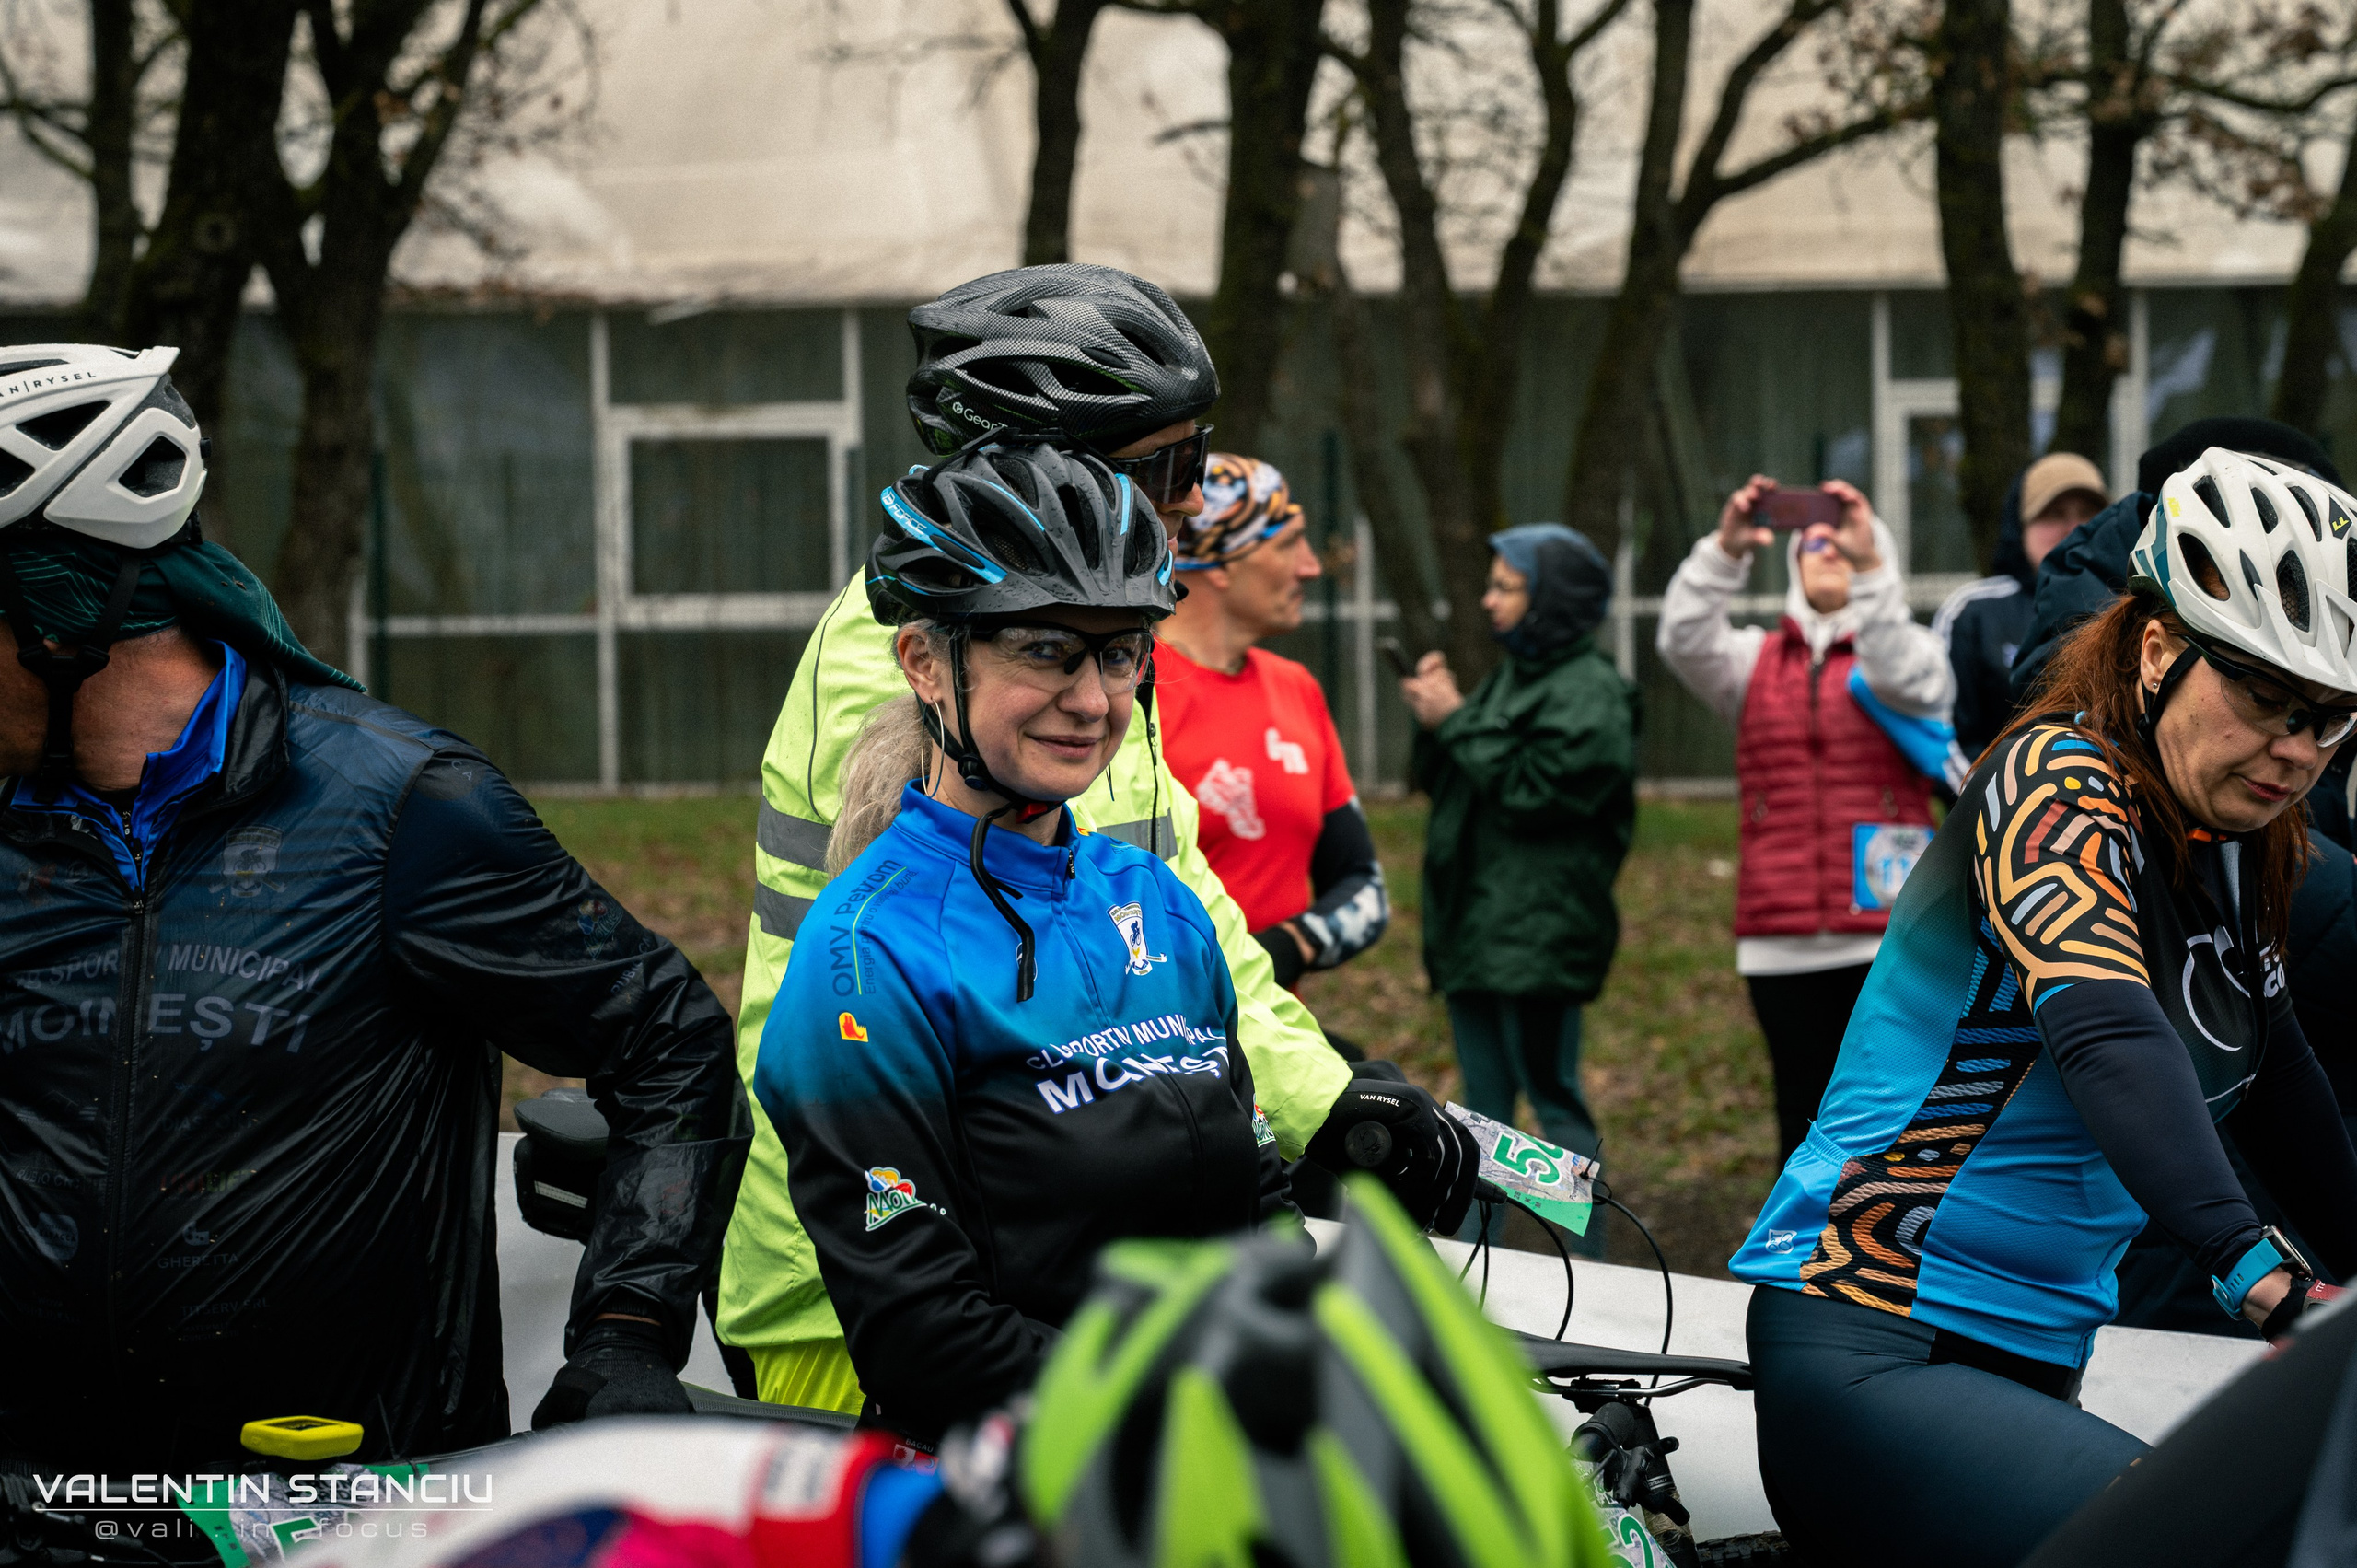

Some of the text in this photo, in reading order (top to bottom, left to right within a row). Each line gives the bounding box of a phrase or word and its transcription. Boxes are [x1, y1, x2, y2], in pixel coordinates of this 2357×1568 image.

[32, 371, 97, 389] RYSEL
[829, 859, 902, 997] OMV Petrom
[168, 943, 323, 995] MUNICIPAL
[1359, 1093, 1399, 1108] VAN RYSEL
